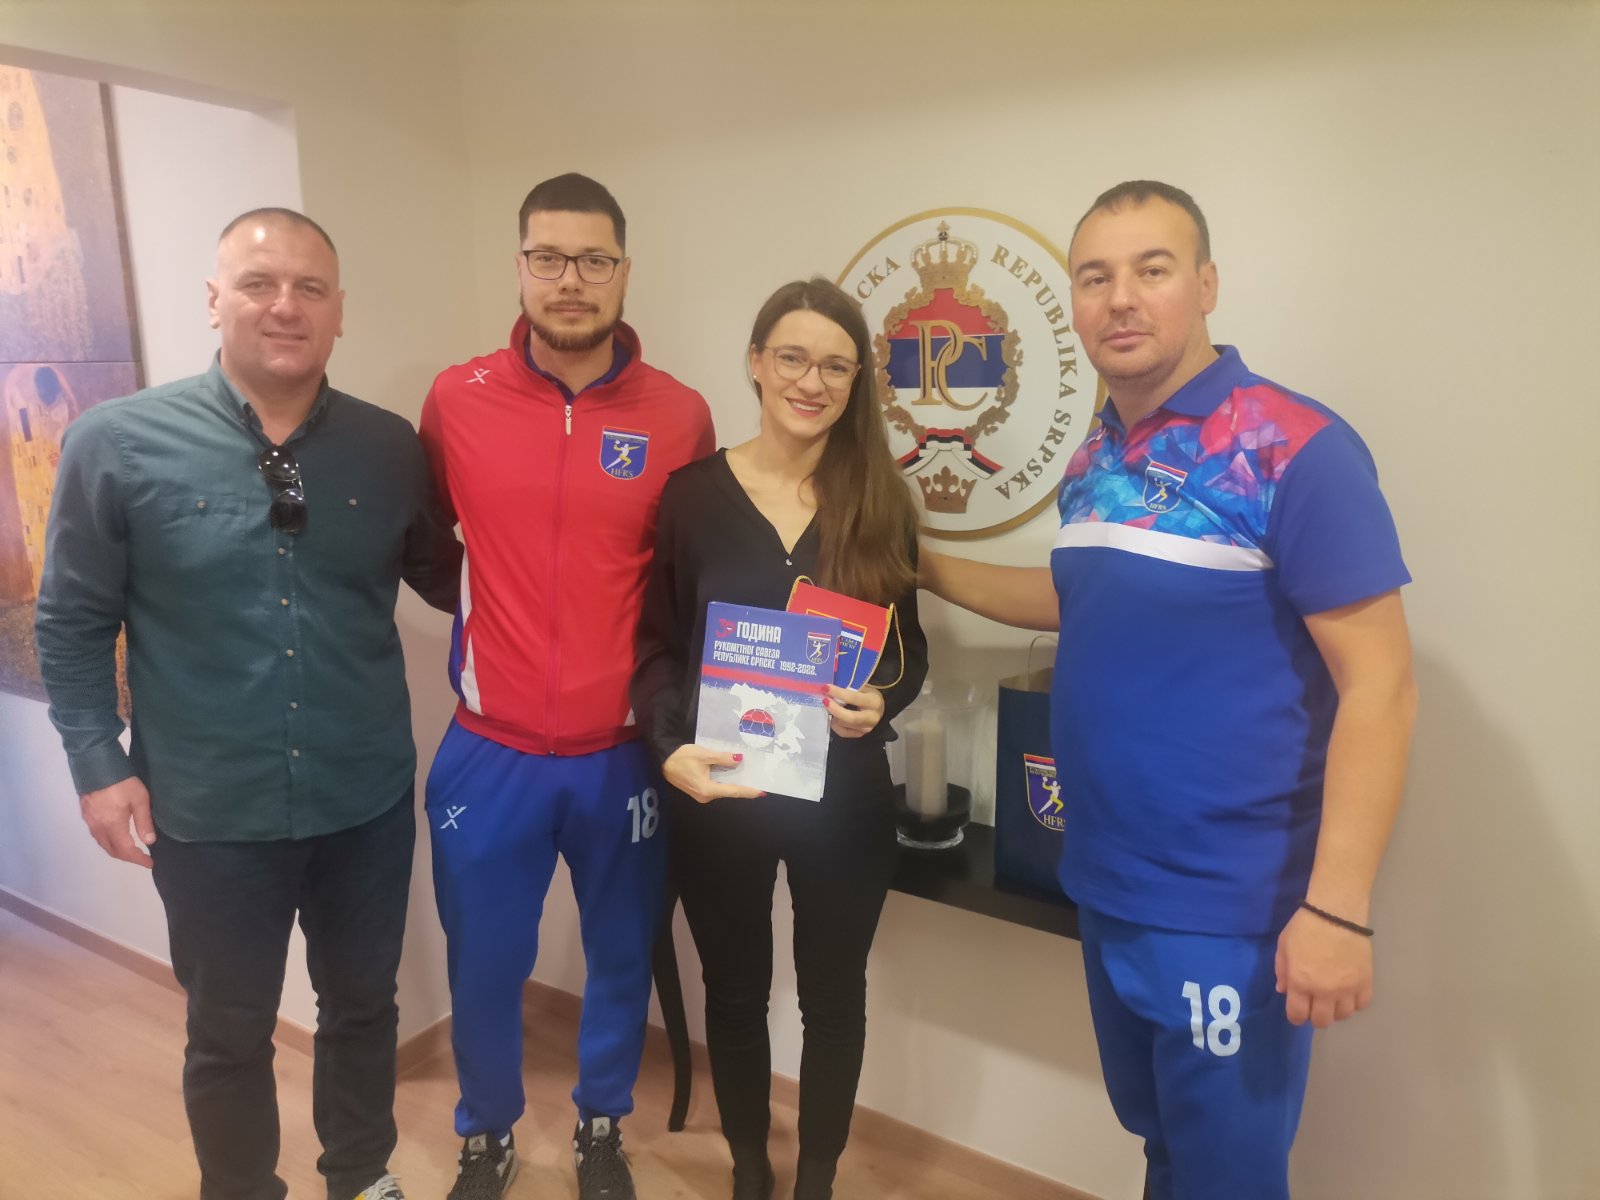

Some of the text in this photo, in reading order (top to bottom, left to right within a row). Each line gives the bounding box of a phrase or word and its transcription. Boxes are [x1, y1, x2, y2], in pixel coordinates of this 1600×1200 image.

[857, 257, 901, 300] СКА
[990, 244, 1078, 500] REPUBLIKA SRPSKA
[736, 621, 782, 643] ГОДИНА
[713, 650, 817, 676] РЕПУБЛИКЕ СРПСКЕ 1992-2022.
[714, 640, 780, 659] РУКОМЕТНОГ САВЕЗА
[626, 787, 660, 843] 18
[1043, 814, 1066, 828] HFR
[1182, 980, 1241, 1057] 18
